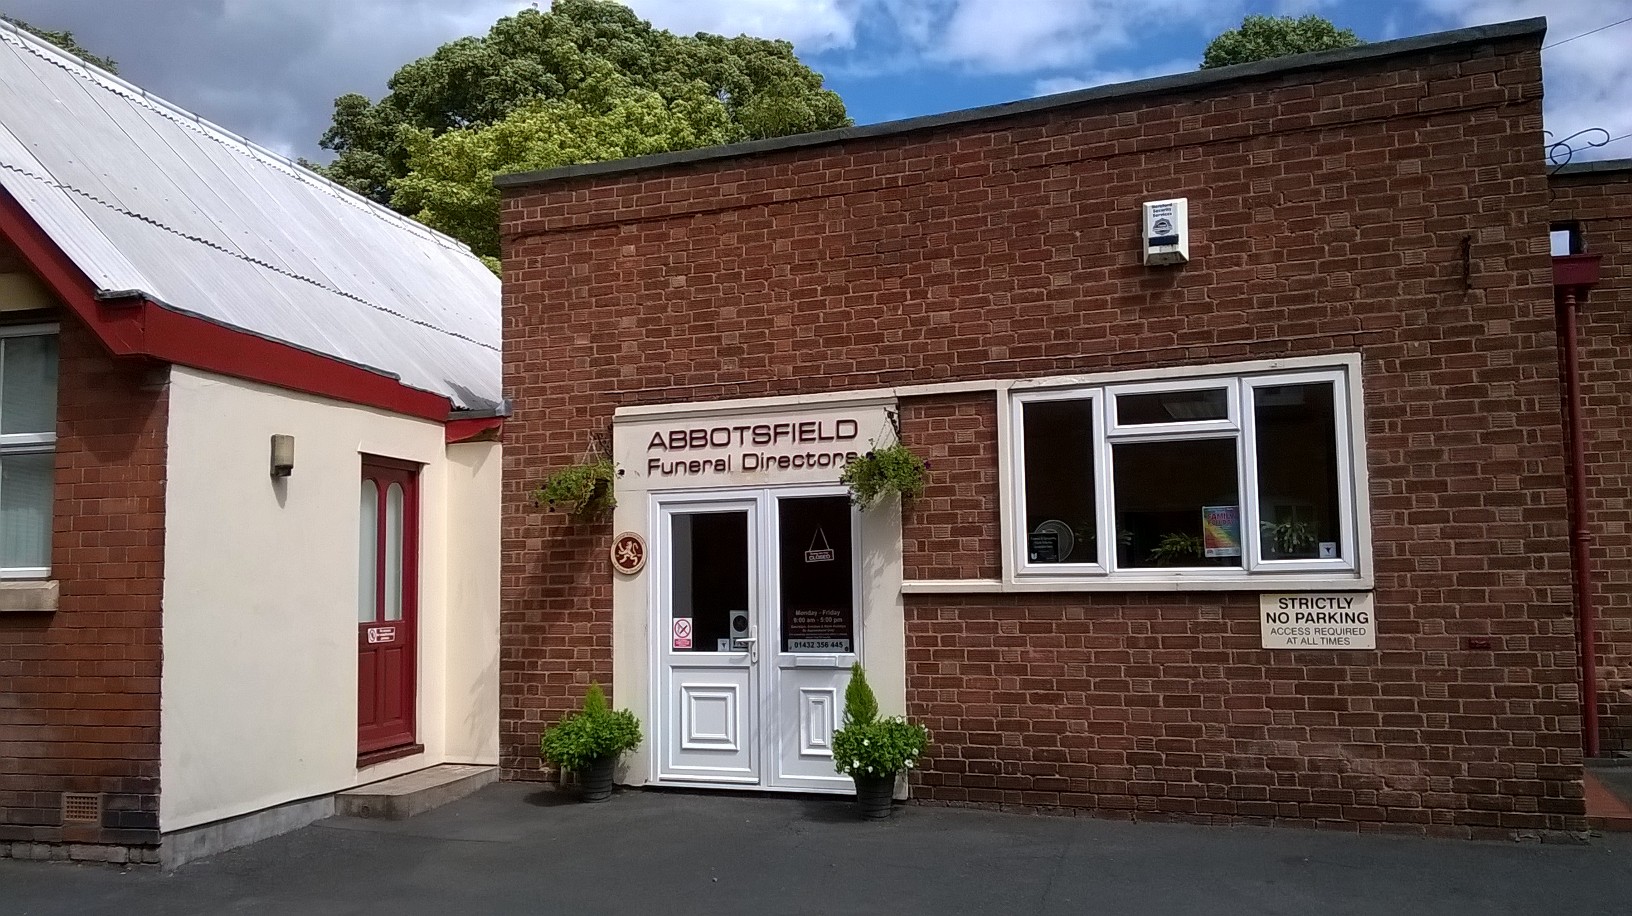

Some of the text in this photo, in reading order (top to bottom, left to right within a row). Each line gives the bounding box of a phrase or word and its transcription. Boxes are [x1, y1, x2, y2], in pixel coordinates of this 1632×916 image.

[647, 418, 859, 450] ABBOTSFIELD
[647, 450, 859, 476] Funeral Directors
[1278, 597, 1354, 610] STRICTLY
[1265, 611, 1369, 624] NO PARKING
[1270, 627, 1367, 636] ACCESS REQUIRED
[794, 641, 815, 649] 01432
[1286, 637, 1351, 646] AT ALL TIMES
